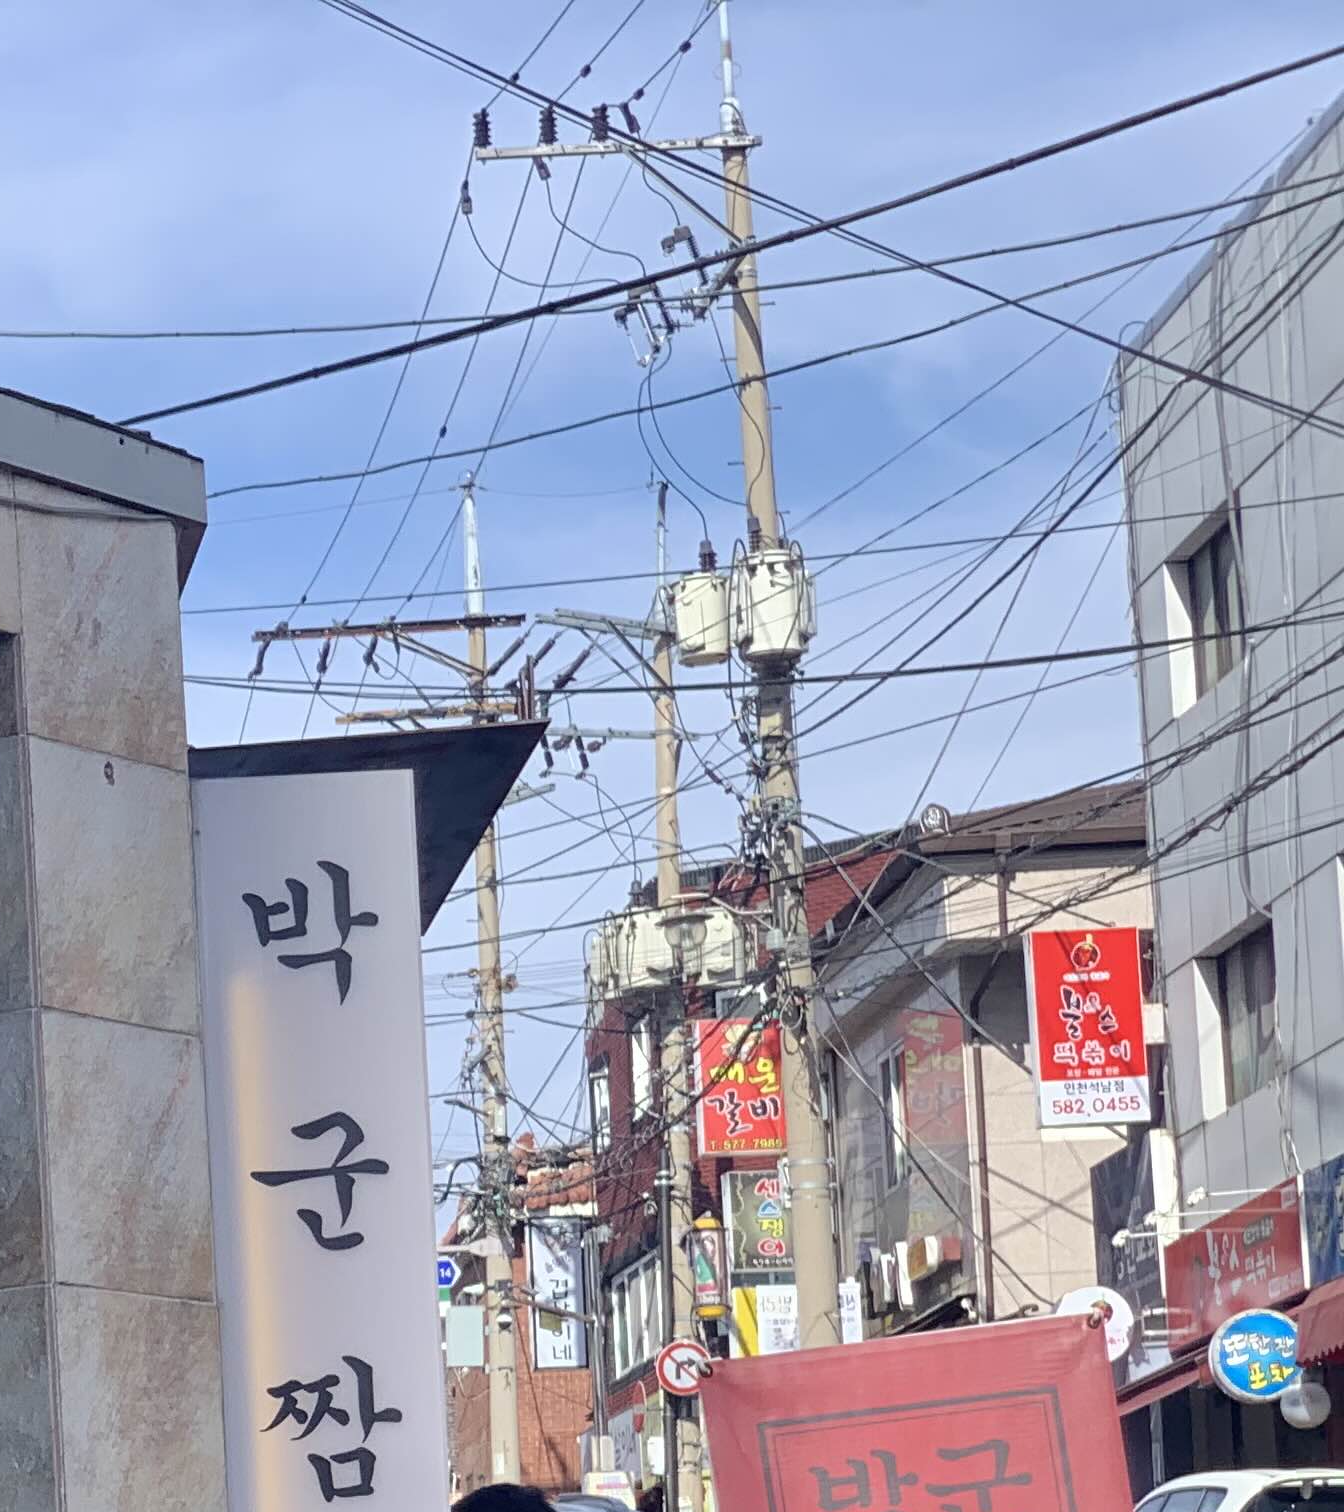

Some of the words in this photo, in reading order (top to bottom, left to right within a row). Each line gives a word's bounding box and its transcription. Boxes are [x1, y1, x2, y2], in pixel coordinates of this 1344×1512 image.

[1053, 1039, 1131, 1067] 떡볶이
[705, 1089, 781, 1135] 갈비
[439, 1267, 452, 1278] 14
[1248, 1362, 1295, 1390] 포차
